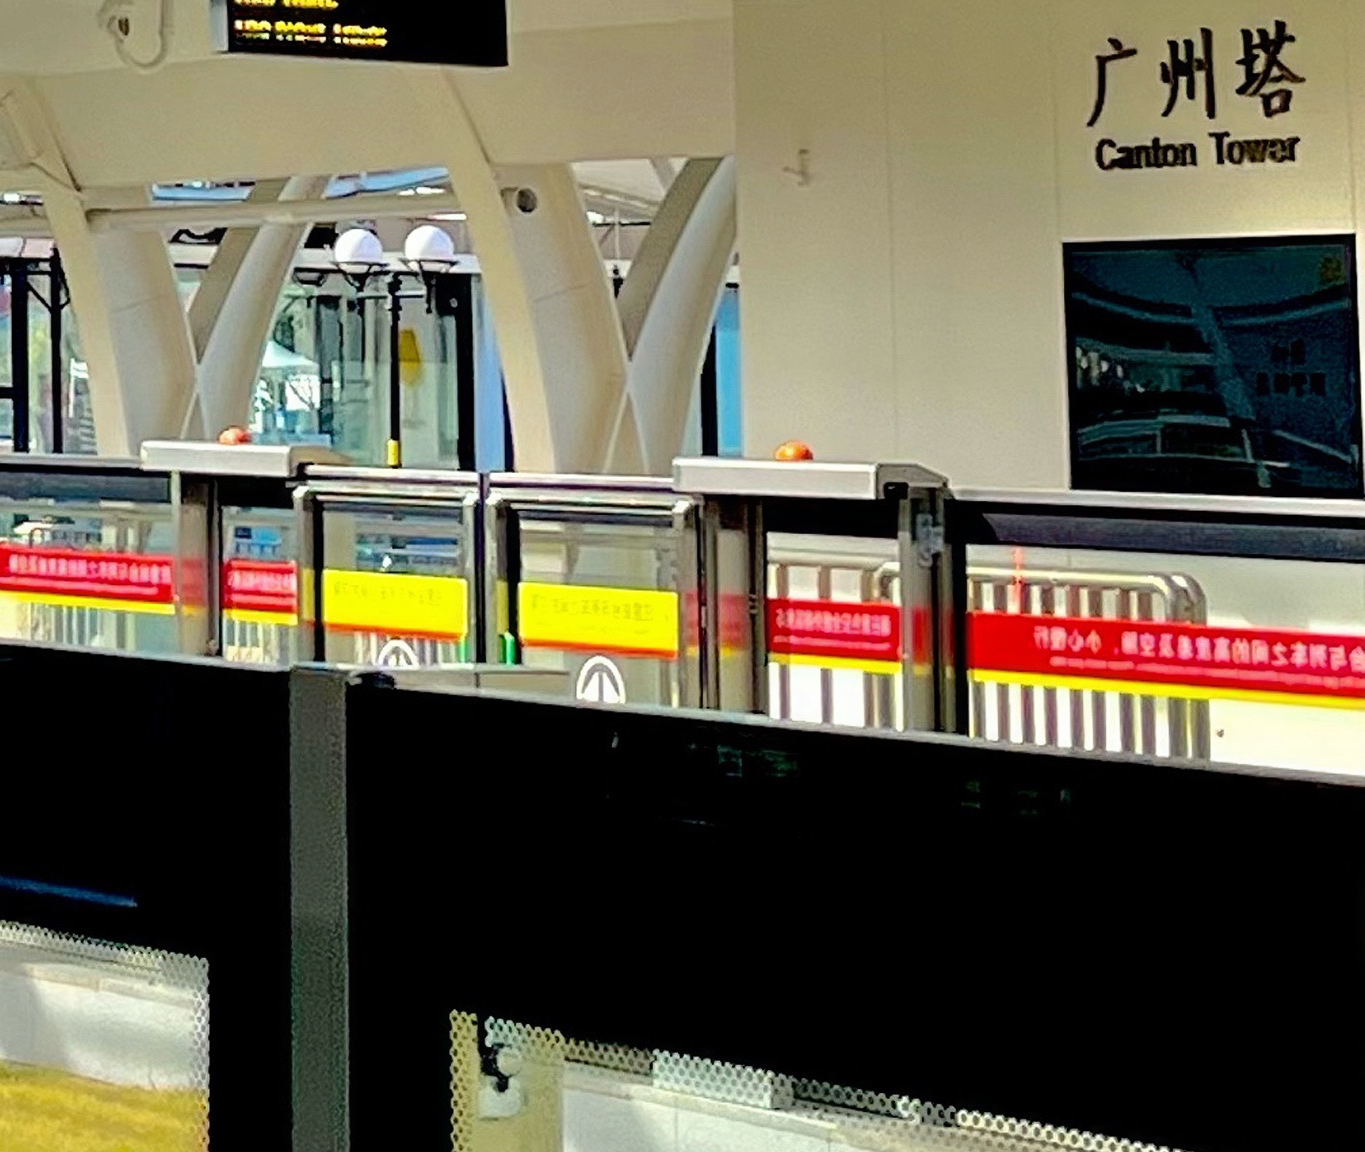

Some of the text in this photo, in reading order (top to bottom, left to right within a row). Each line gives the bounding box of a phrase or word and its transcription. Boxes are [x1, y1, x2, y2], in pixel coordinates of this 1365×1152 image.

[1086, 19, 1306, 127] 广州塔
[1095, 130, 1301, 170] Canton Tower
